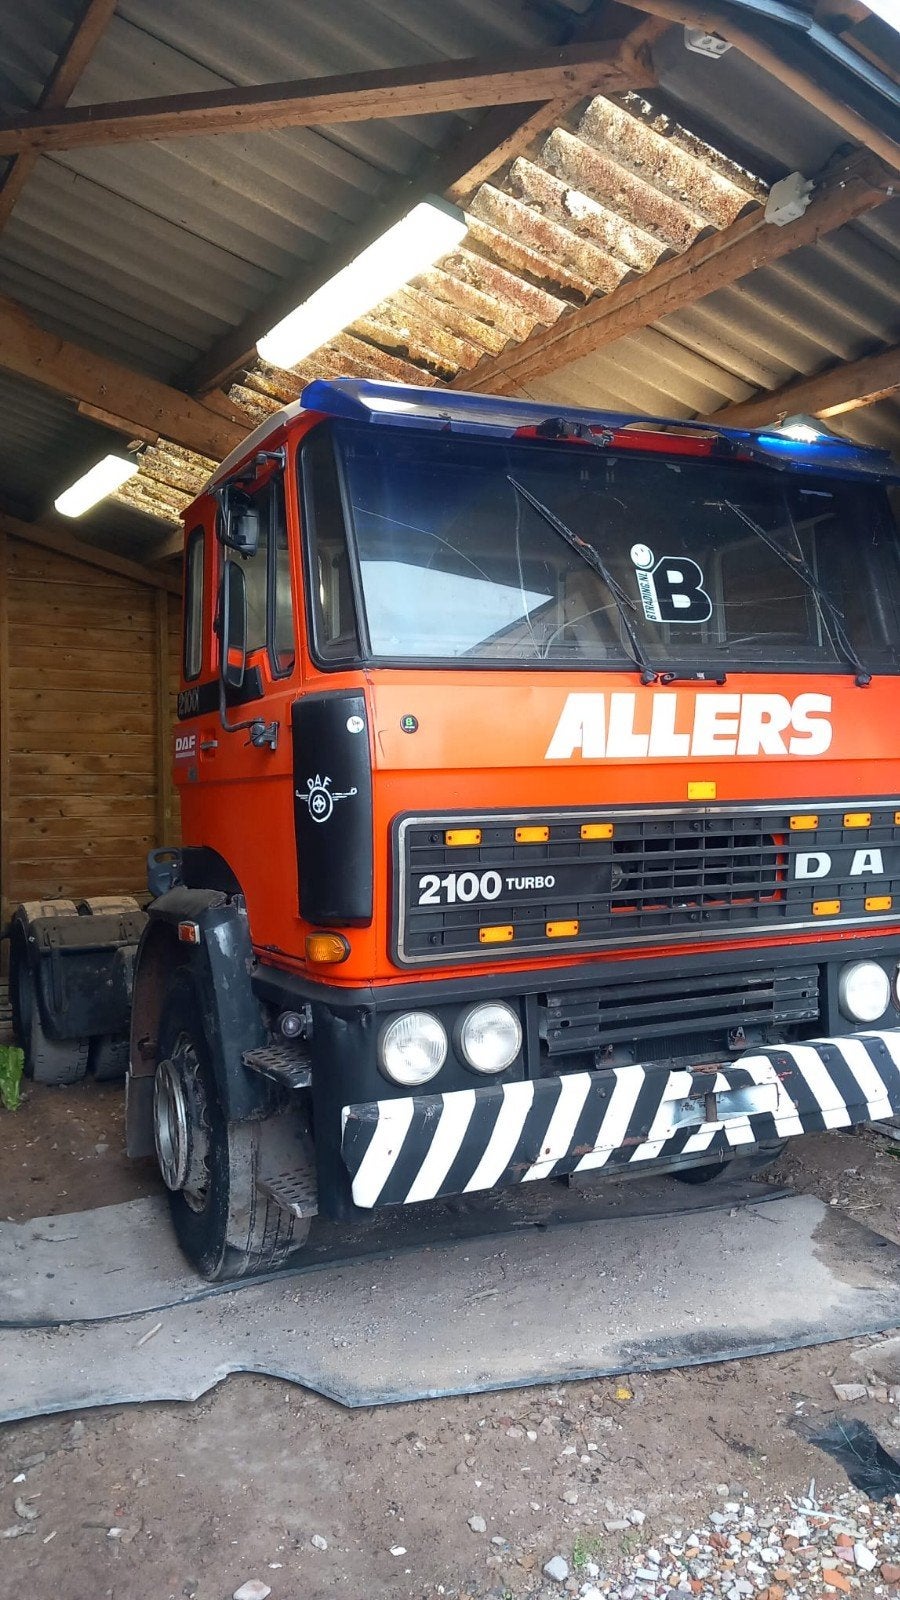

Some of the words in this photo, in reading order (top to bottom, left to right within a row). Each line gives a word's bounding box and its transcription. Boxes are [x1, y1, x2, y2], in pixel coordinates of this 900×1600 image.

[544, 692, 833, 760] ALLERS
[175, 735, 196, 752] DAF
[306, 774, 332, 789] DAF
[418, 870, 502, 905] 2100
[506, 875, 556, 891] TURBO
